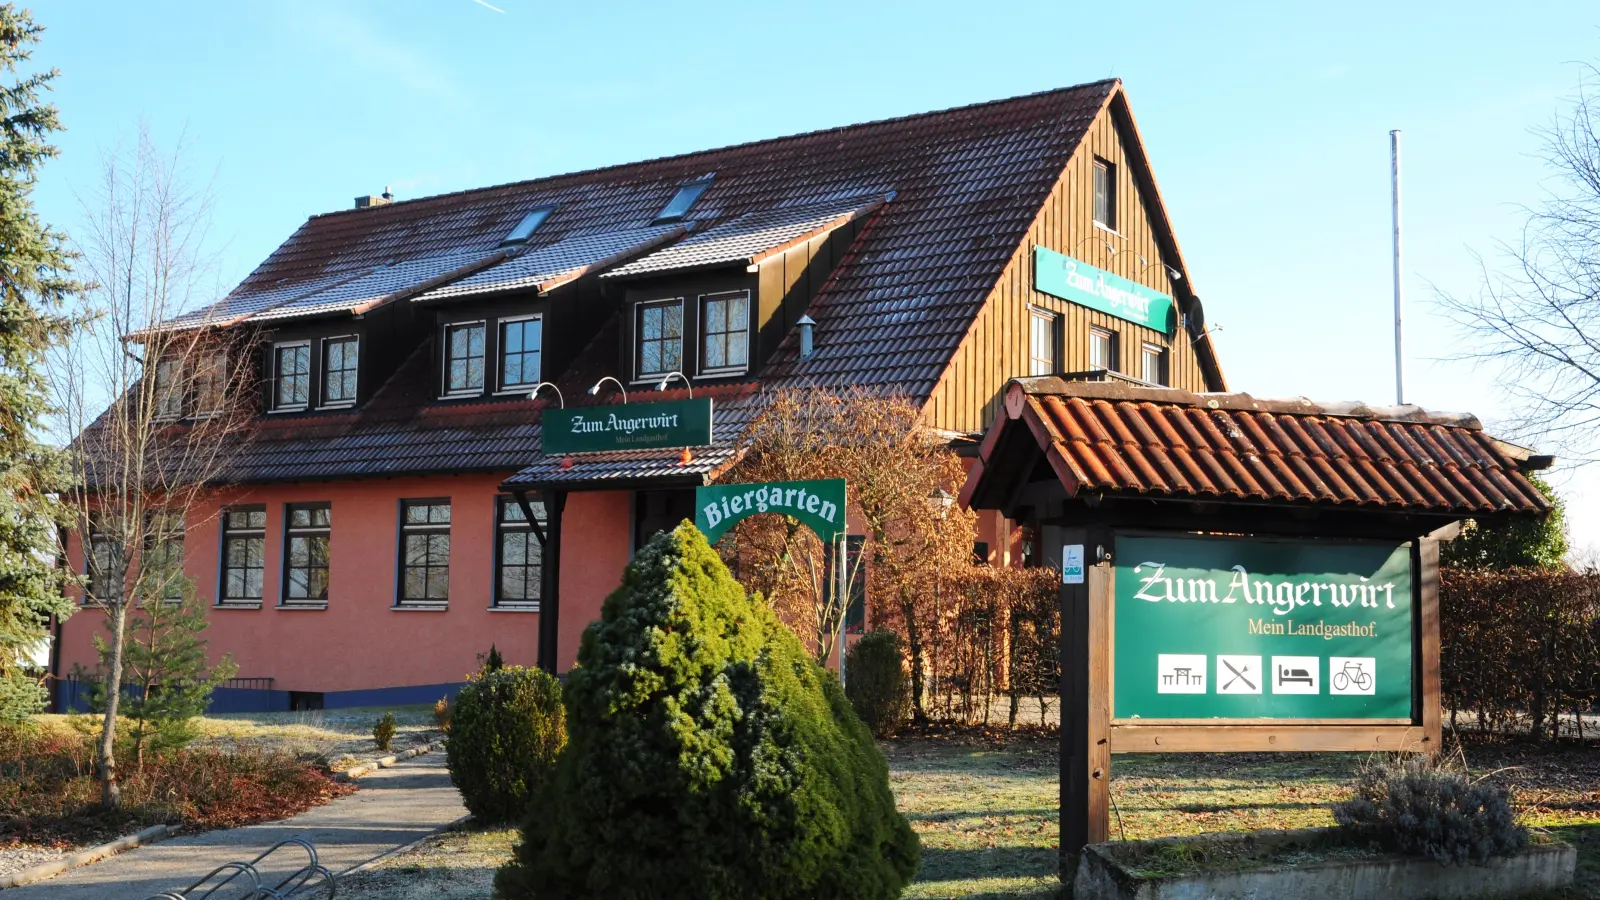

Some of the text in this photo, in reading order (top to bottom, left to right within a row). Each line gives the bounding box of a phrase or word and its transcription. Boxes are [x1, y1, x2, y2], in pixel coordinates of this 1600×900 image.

[1065, 261, 1093, 294] Zum
[571, 413, 678, 434] Zum Angerwirt
[615, 435, 631, 443] Mein
[703, 485, 837, 529] Biergarten
[1134, 561, 1396, 616] Zum Angerwirt
[1248, 618, 1378, 640] Mein Landgasthof.
